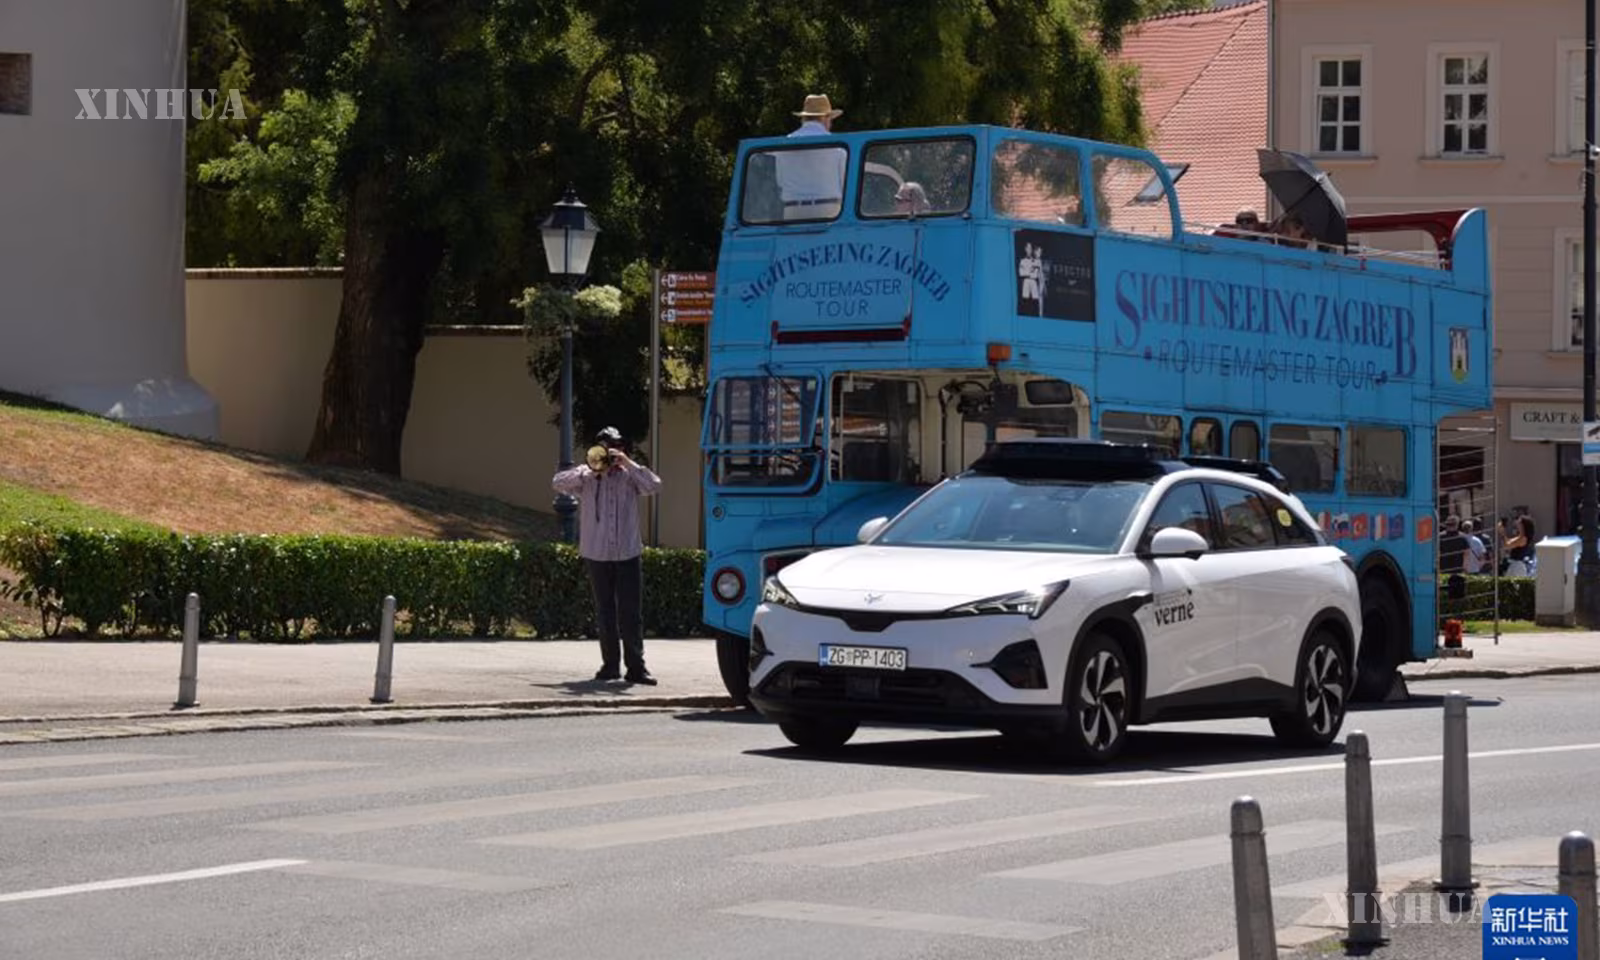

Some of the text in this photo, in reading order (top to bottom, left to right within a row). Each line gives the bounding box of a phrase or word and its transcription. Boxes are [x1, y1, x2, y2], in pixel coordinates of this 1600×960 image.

[740, 242, 951, 308] SIGHTSEEING ZAGREB
[786, 279, 902, 299] ROUTEMASTER
[815, 299, 869, 317] TOUR
[1114, 269, 1417, 379] SIGHTSEEING ZAGREB
[1158, 338, 1377, 390] ROUTEMASTER TOUR
[1523, 411, 1567, 424] CRAFT
[1570, 411, 1581, 424] &
[829, 647, 846, 665] ZG
